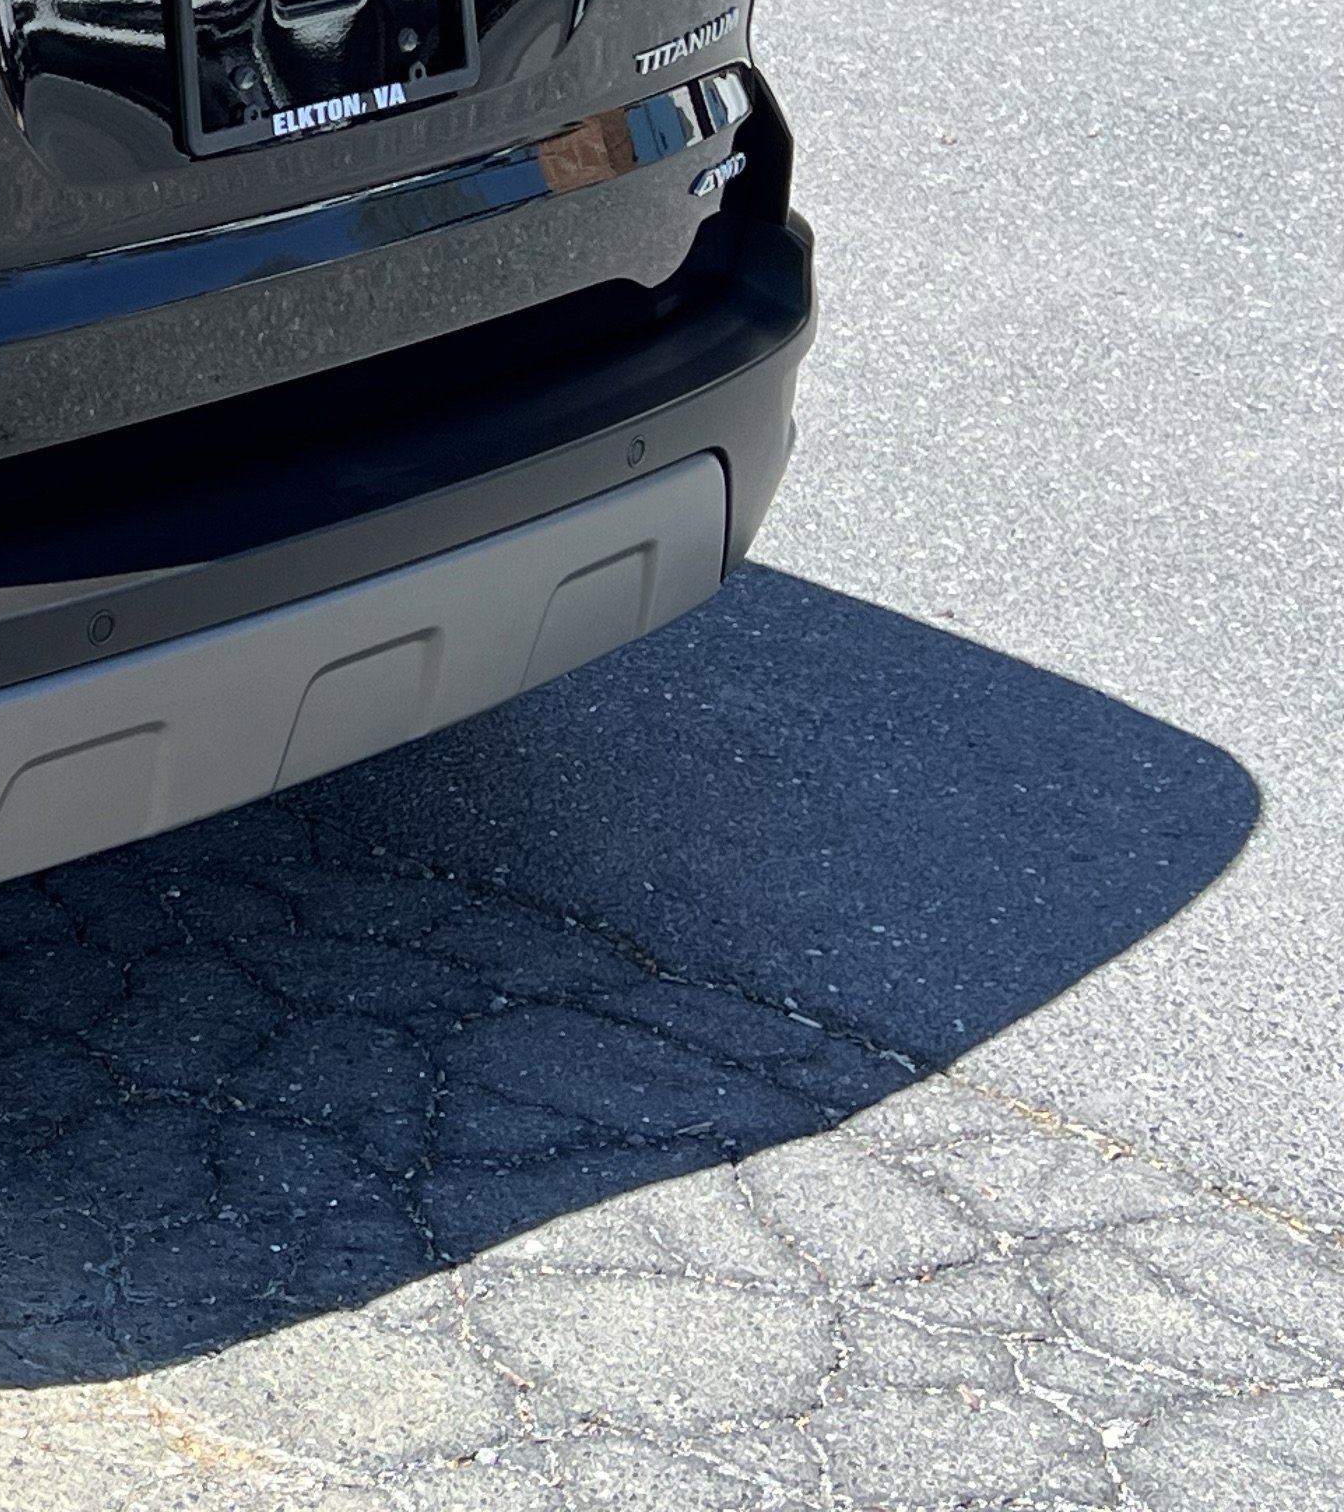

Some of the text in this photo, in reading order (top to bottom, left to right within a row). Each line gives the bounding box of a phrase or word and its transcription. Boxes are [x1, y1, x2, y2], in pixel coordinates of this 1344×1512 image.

[634, 6, 740, 75] TITANIUM
[272, 82, 407, 136] ELKTON, VA
[693, 152, 746, 197] 4WD
